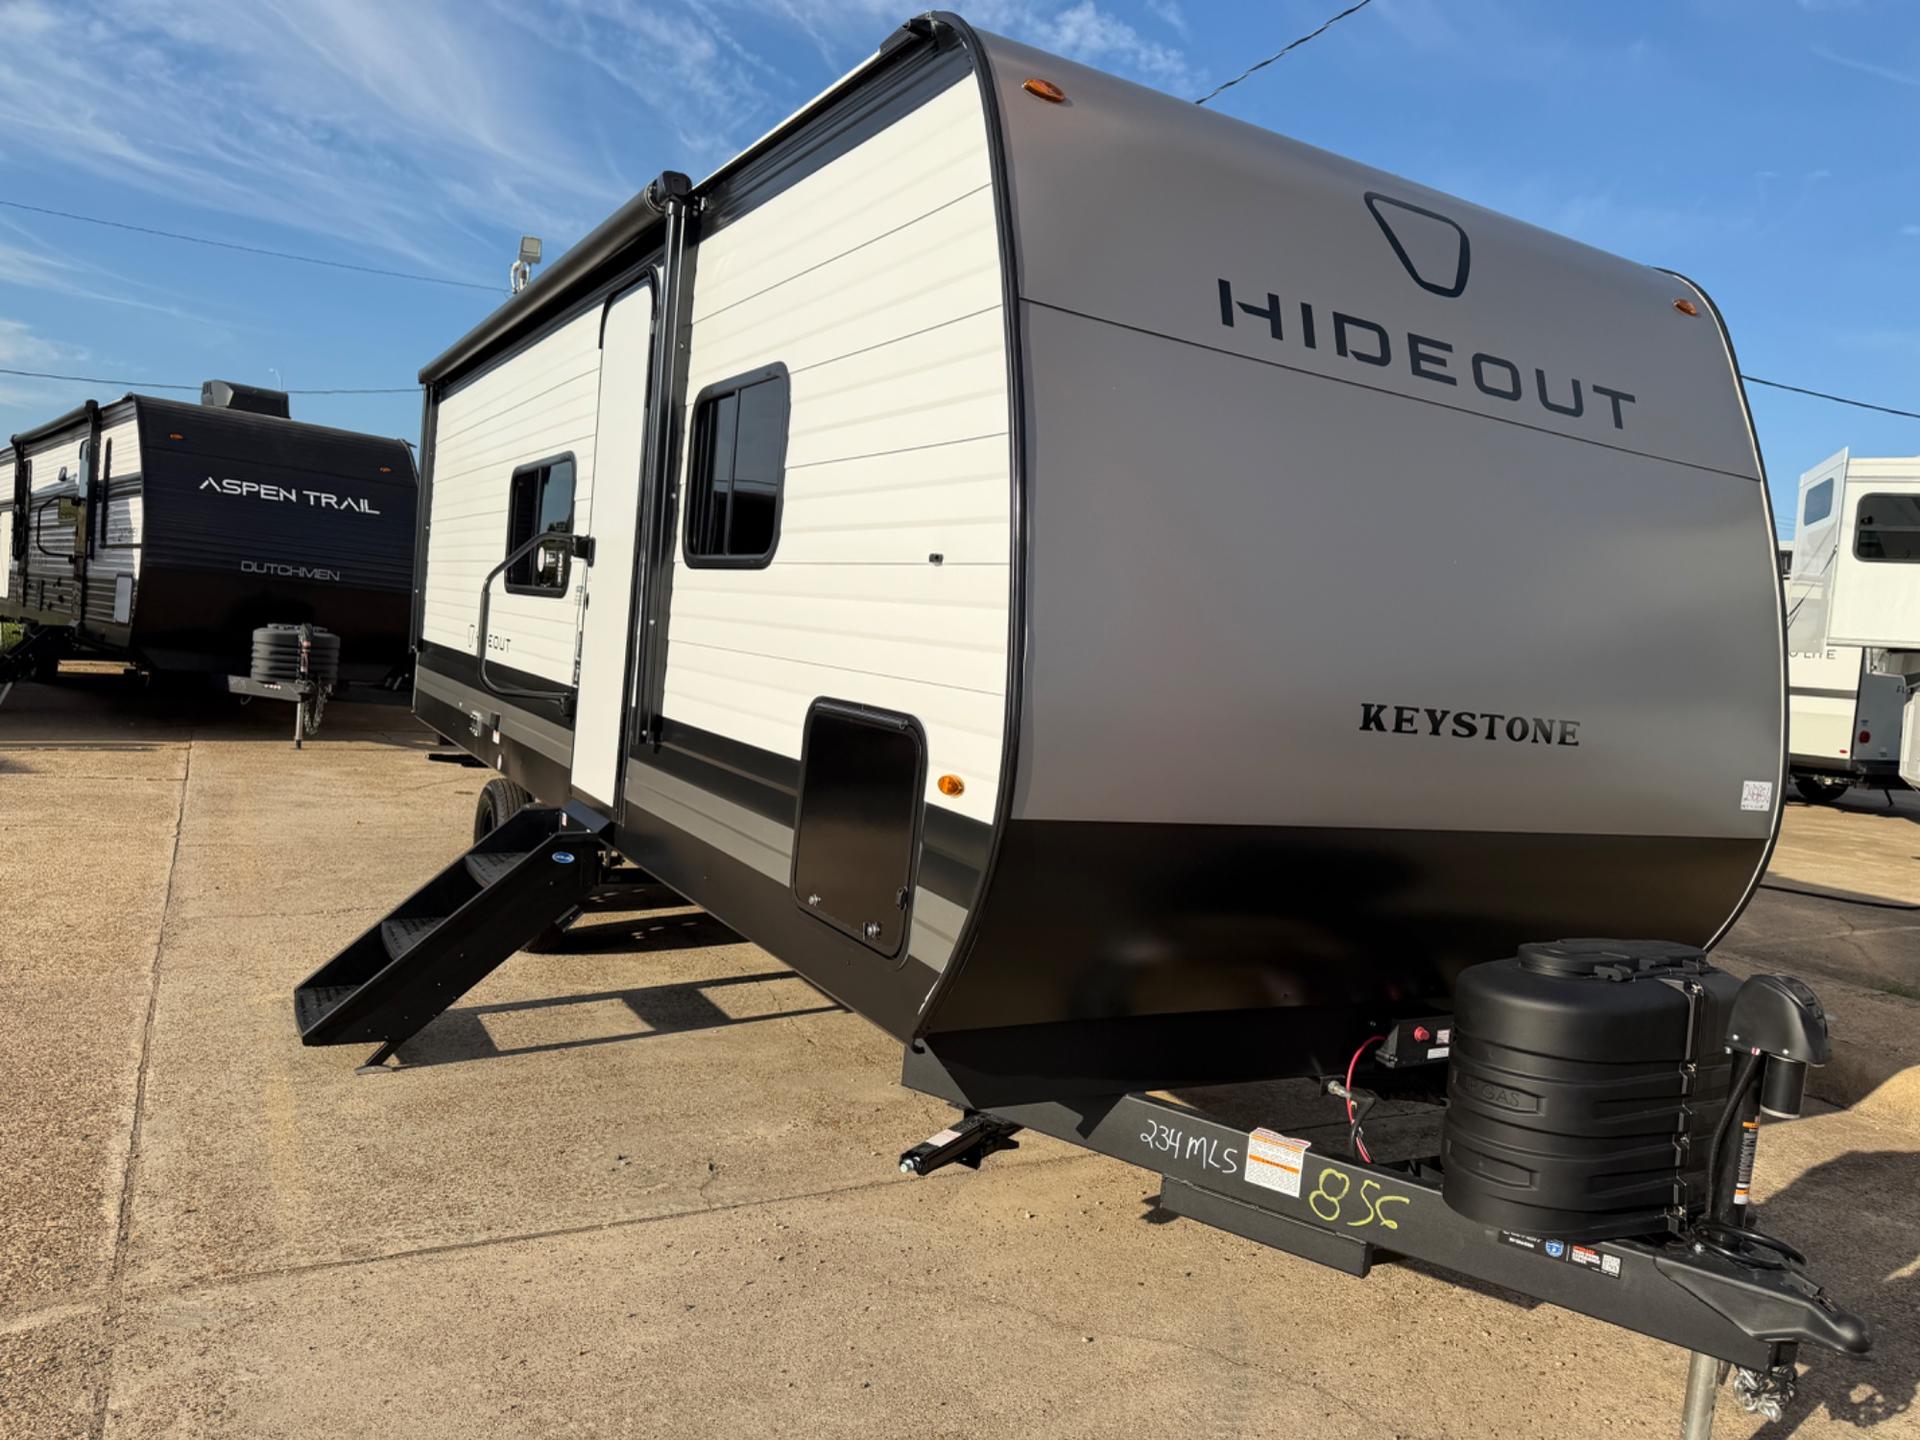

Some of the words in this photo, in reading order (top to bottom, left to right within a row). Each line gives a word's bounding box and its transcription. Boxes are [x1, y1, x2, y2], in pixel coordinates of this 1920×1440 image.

[1217, 278, 1637, 430] HIDEOUT
[199, 476, 297, 503] ASPEN
[302, 490, 381, 515] TRAIL
[240, 560, 341, 581] DUTCHMEN
[1358, 702, 1581, 747] KEYSTONE
[1481, 1083, 1520, 1107] GAS
